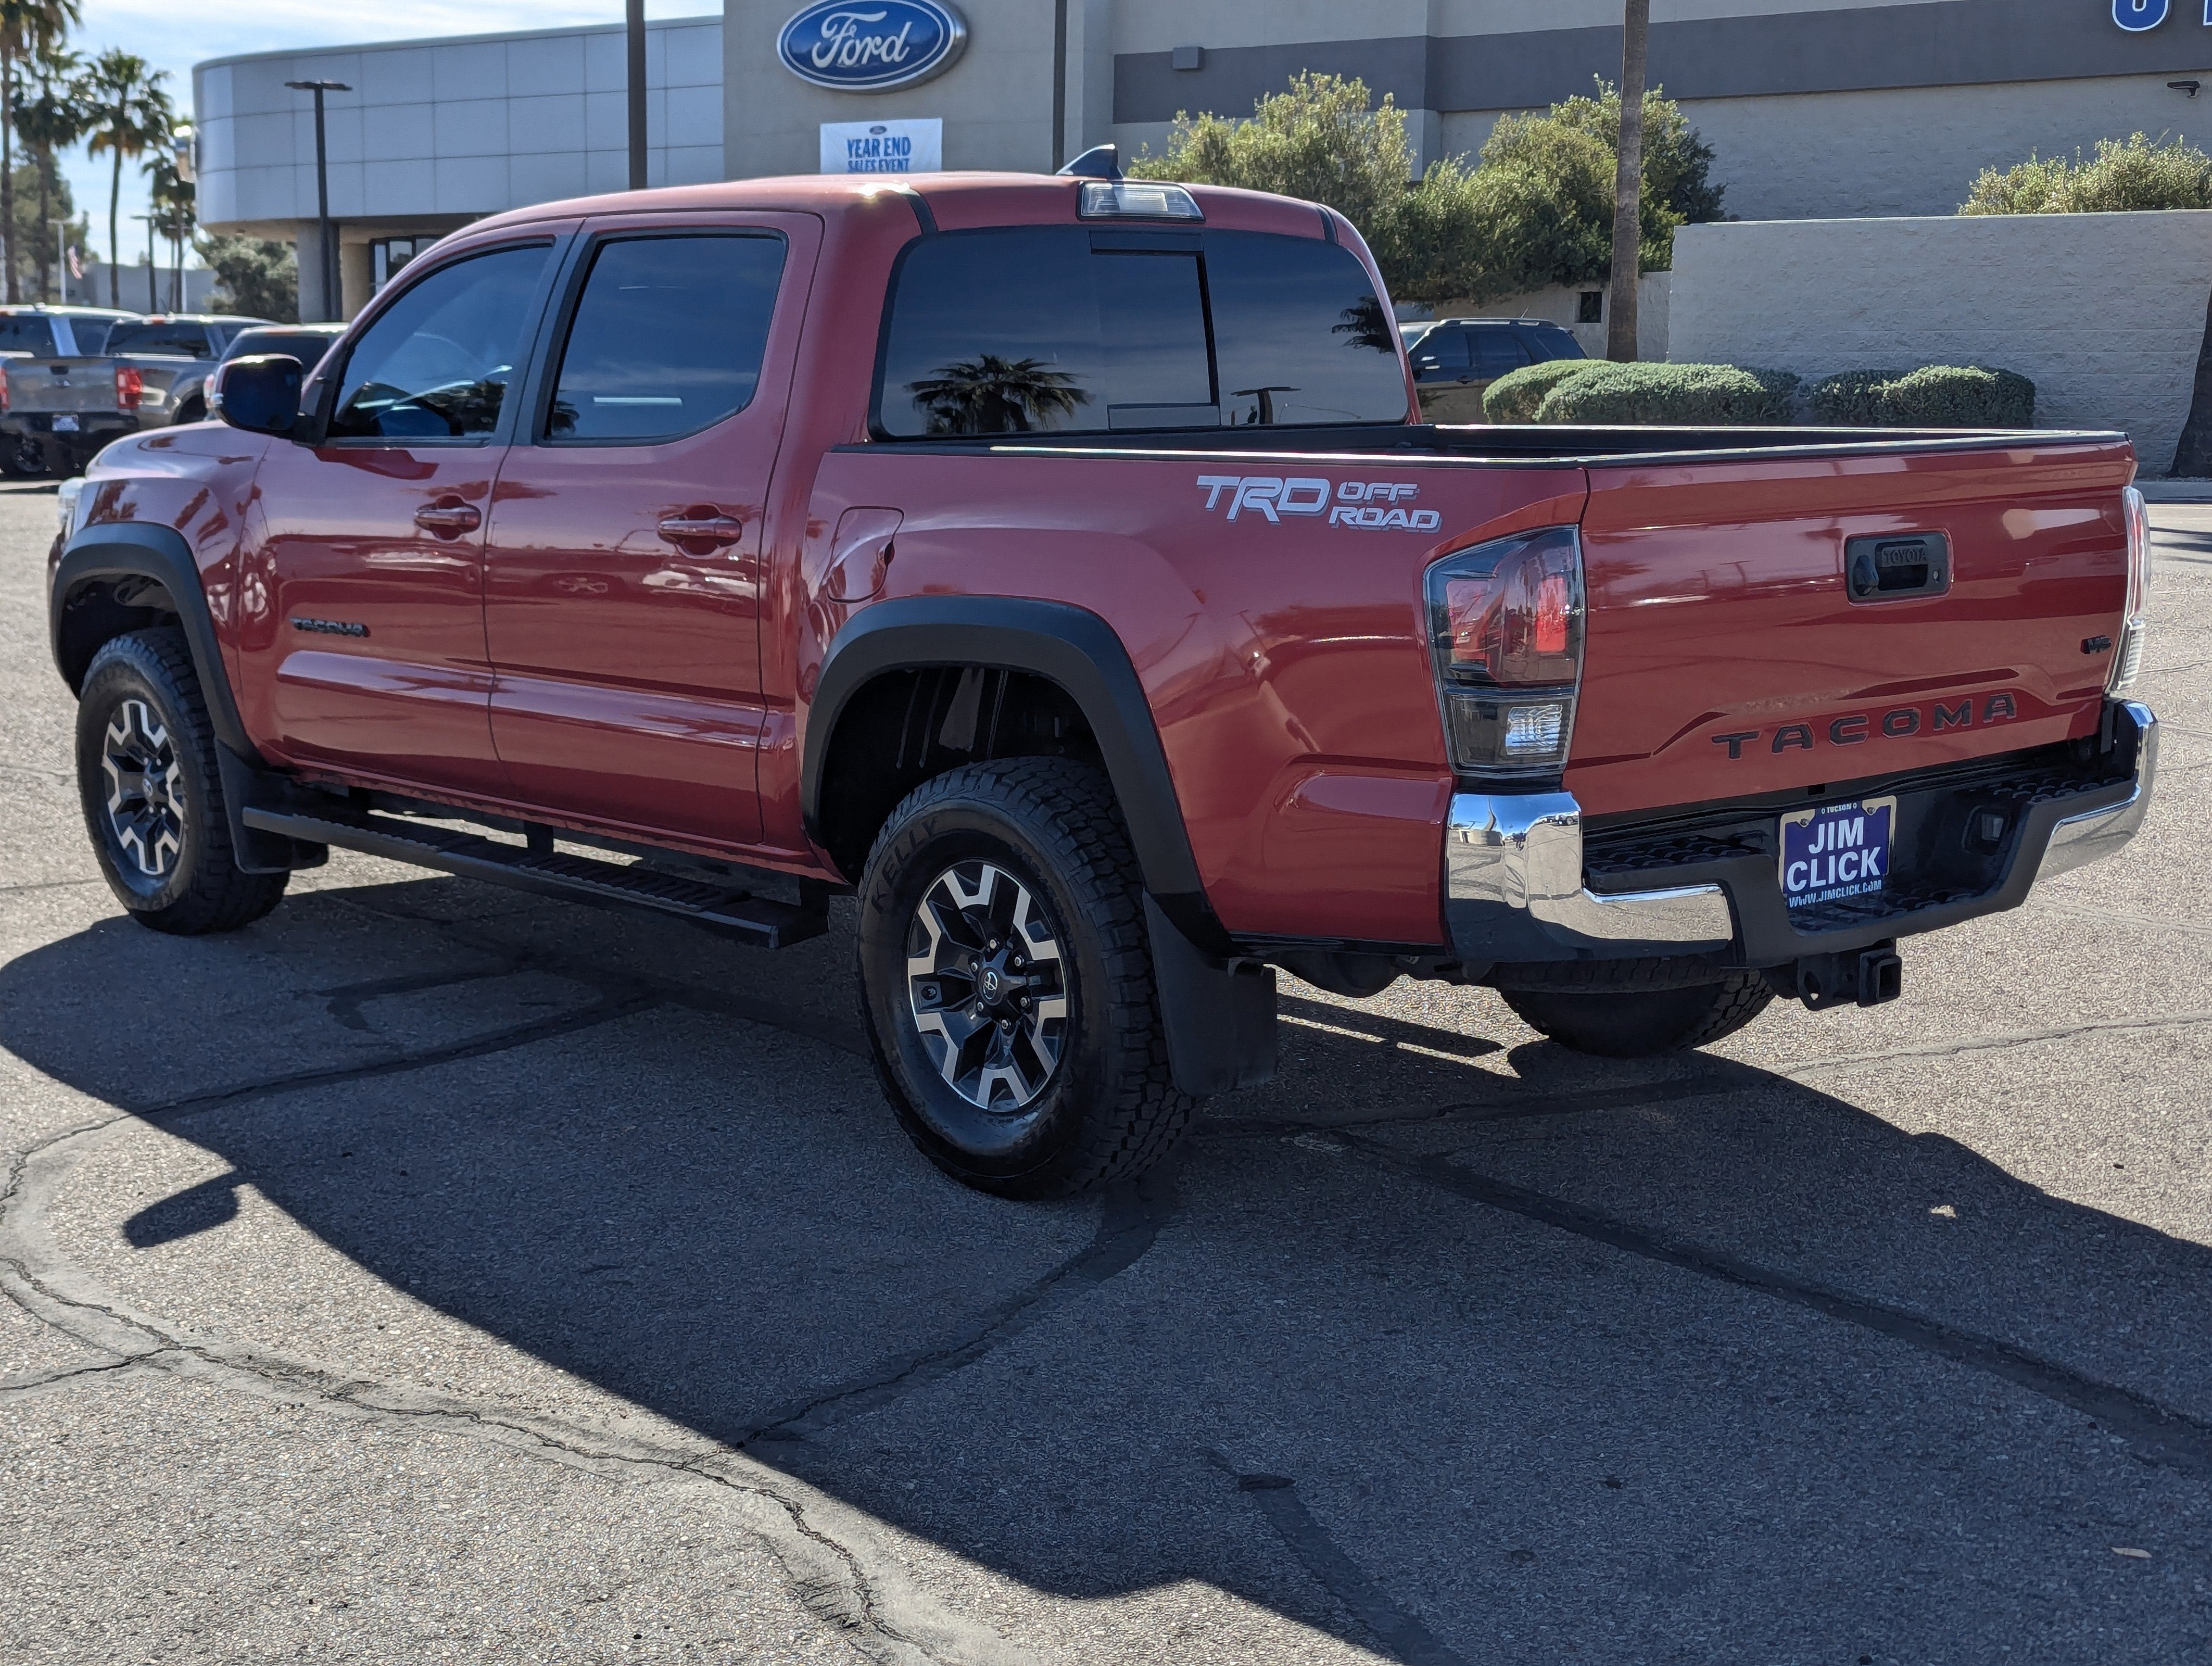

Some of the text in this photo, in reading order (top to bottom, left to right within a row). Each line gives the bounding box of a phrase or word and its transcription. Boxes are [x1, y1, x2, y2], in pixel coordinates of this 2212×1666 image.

[812, 11, 912, 68] Ford
[847, 137, 911, 158] YEAR END
[878, 158, 910, 172] EVENT
[1196, 475, 1422, 526] TRD OFF
[1328, 506, 1442, 534] ROAD
[1712, 692, 2017, 760] TACOMA
[1808, 816, 1864, 855] JIM
[871, 816, 939, 914] KELLY
[1787, 847, 1881, 892] CLICK
[1789, 879, 1882, 908] WWW.JIMCLICK.COM
